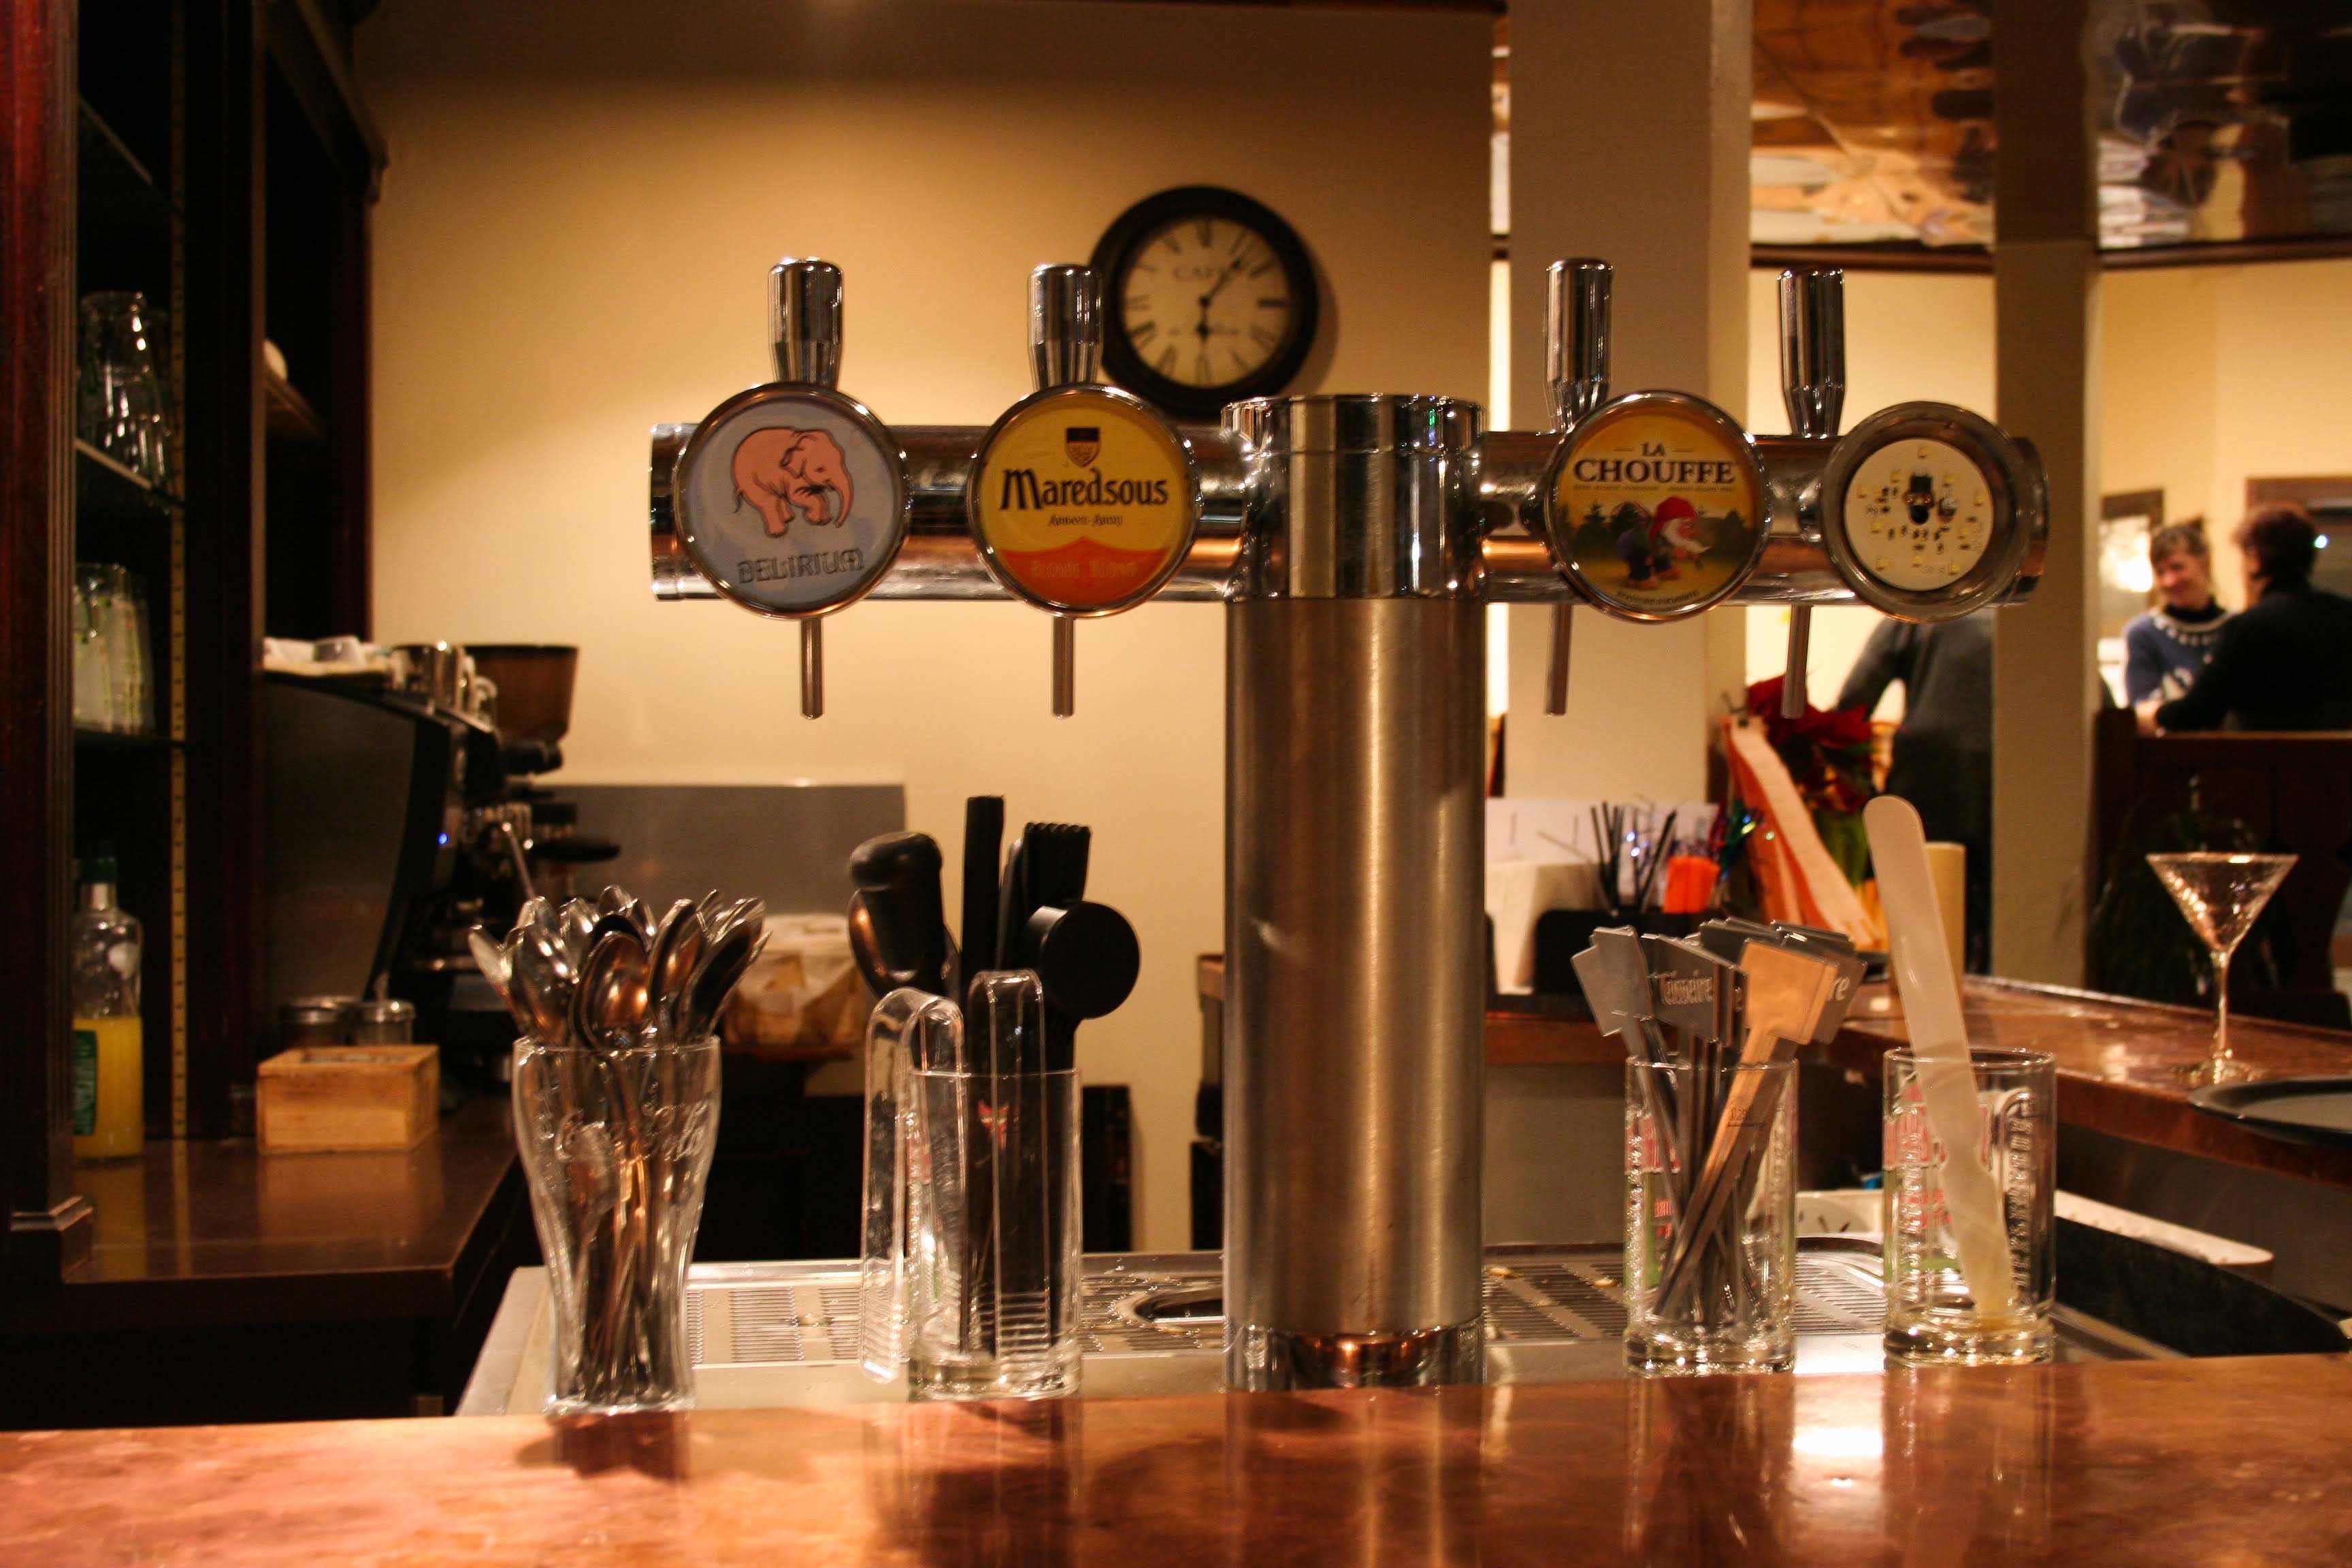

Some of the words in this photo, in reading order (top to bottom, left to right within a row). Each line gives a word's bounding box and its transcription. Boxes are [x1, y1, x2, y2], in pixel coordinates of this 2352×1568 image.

[1642, 443, 1667, 457] LA
[1574, 459, 1736, 484] CHOUFFE
[1000, 468, 1170, 510] Maredsous
[737, 548, 865, 584] DELIRIUM
